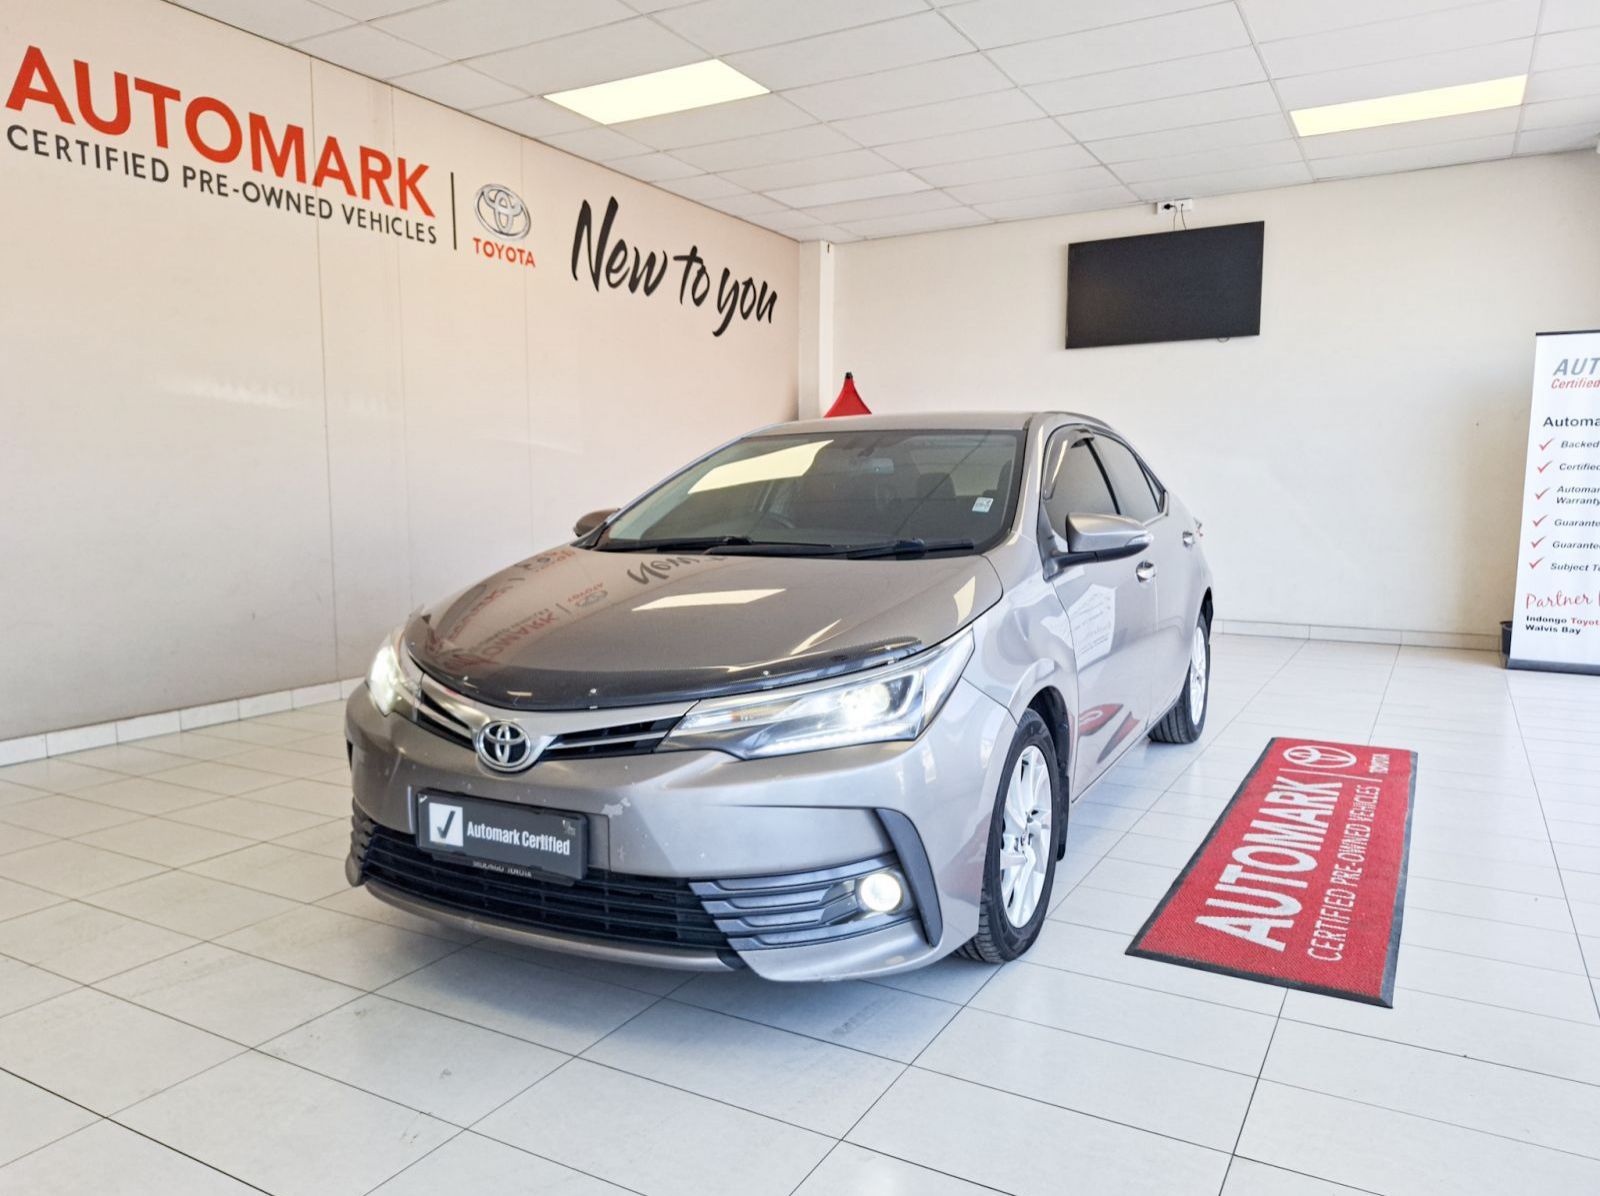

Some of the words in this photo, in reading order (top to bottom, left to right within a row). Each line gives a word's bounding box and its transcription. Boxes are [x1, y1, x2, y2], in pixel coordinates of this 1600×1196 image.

[5, 45, 435, 218] AUTOMARK
[6, 124, 169, 183] CERTIFIED
[182, 165, 333, 219] PRE-OWNED
[342, 203, 437, 244] VEHICLES
[472, 237, 536, 267] TOYOTA
[571, 196, 667, 296] New
[673, 245, 710, 307] to
[712, 267, 777, 337] you
[1561, 440, 1600, 449] Backed
[1556, 497, 1600, 506] Warranty
[1552, 541, 1600, 549] Guarante
[1551, 562, 1589, 572] Subject
[1526, 590, 1593, 609] Partner
[1525, 624, 1558, 632] Walvis
[1561, 626, 1581, 635] Bay
[1526, 615, 1567, 625] Indongo
[1347, 784, 1381, 823] VEHICLES
[466, 821, 520, 845] Automark
[521, 830, 571, 856] Certified
[1194, 775, 1343, 953] AUTOMARK
[1329, 823, 1371, 888] PRE-OWNED
[1306, 887, 1357, 962] CERTIFIED
